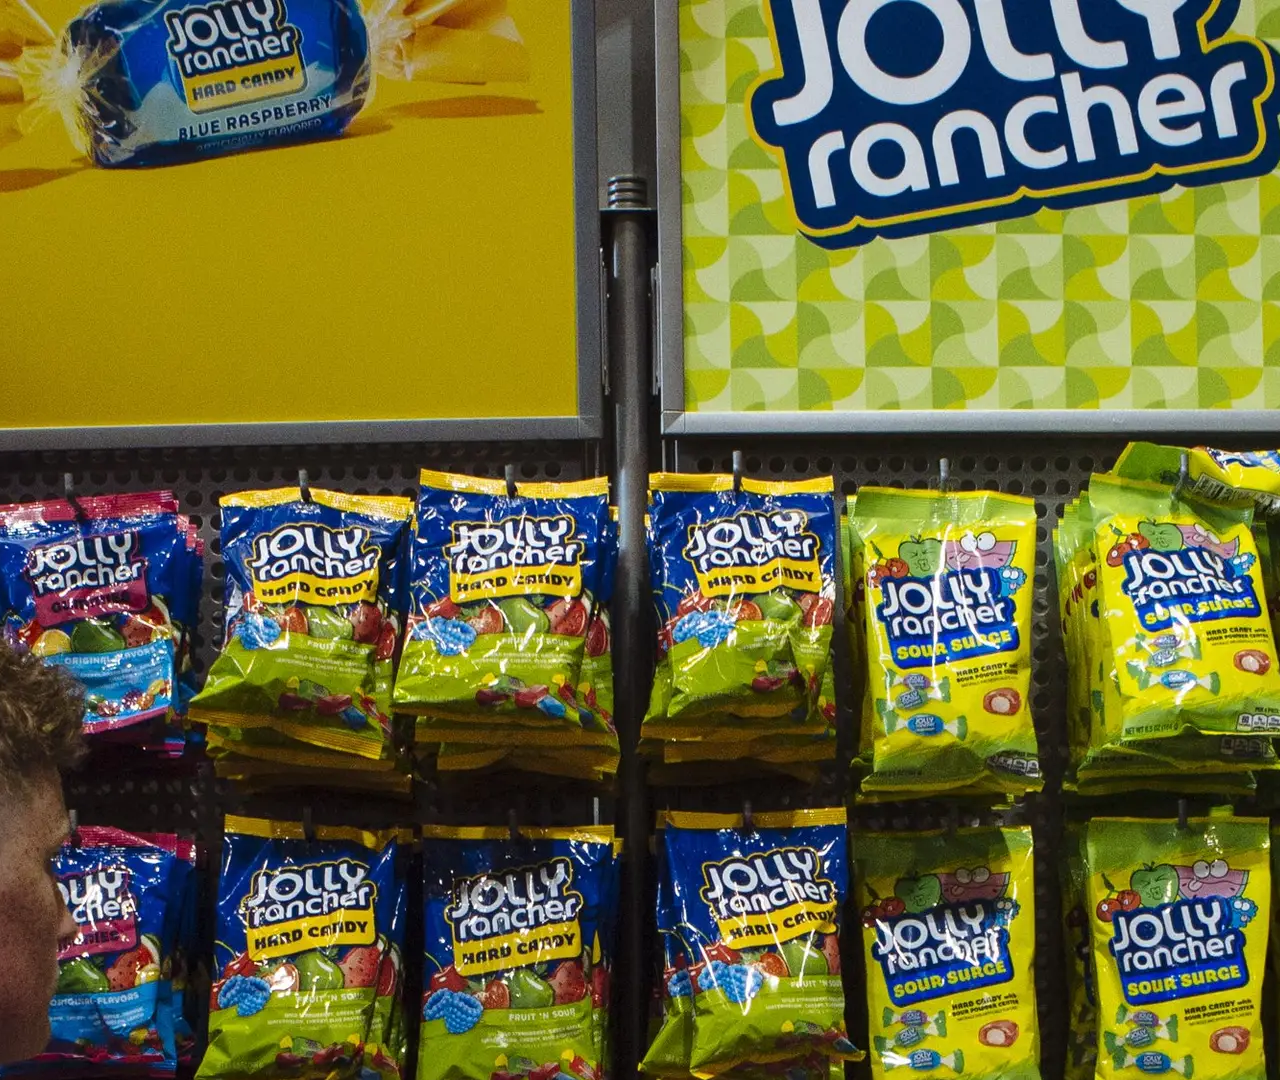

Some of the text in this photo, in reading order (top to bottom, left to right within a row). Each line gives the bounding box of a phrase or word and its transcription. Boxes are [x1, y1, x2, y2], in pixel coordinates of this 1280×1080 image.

[173, 0, 274, 52] JOLLY
[183, 31, 291, 74] rancher
[192, 66, 296, 101] HARD CANDY
[178, 95, 332, 141] BLUE RASPBERRY
[807, 61, 1247, 208] rancher
[252, 527, 363, 567] JOLLY
[259, 553, 375, 580] rancher
[262, 580, 374, 597] HARD CANDY
[883, 572, 990, 616] JOLLY
[892, 602, 1005, 636] rancher
[897, 630, 1012, 659] SOUR SURGE
[1114, 901, 1221, 951] JOLLY
[1122, 934, 1235, 972] rancher
[1128, 965, 1241, 997] SOUR SURGE
[1184, 1005, 1207, 1014] HARD
[1209, 1001, 1235, 1010] CANDY
